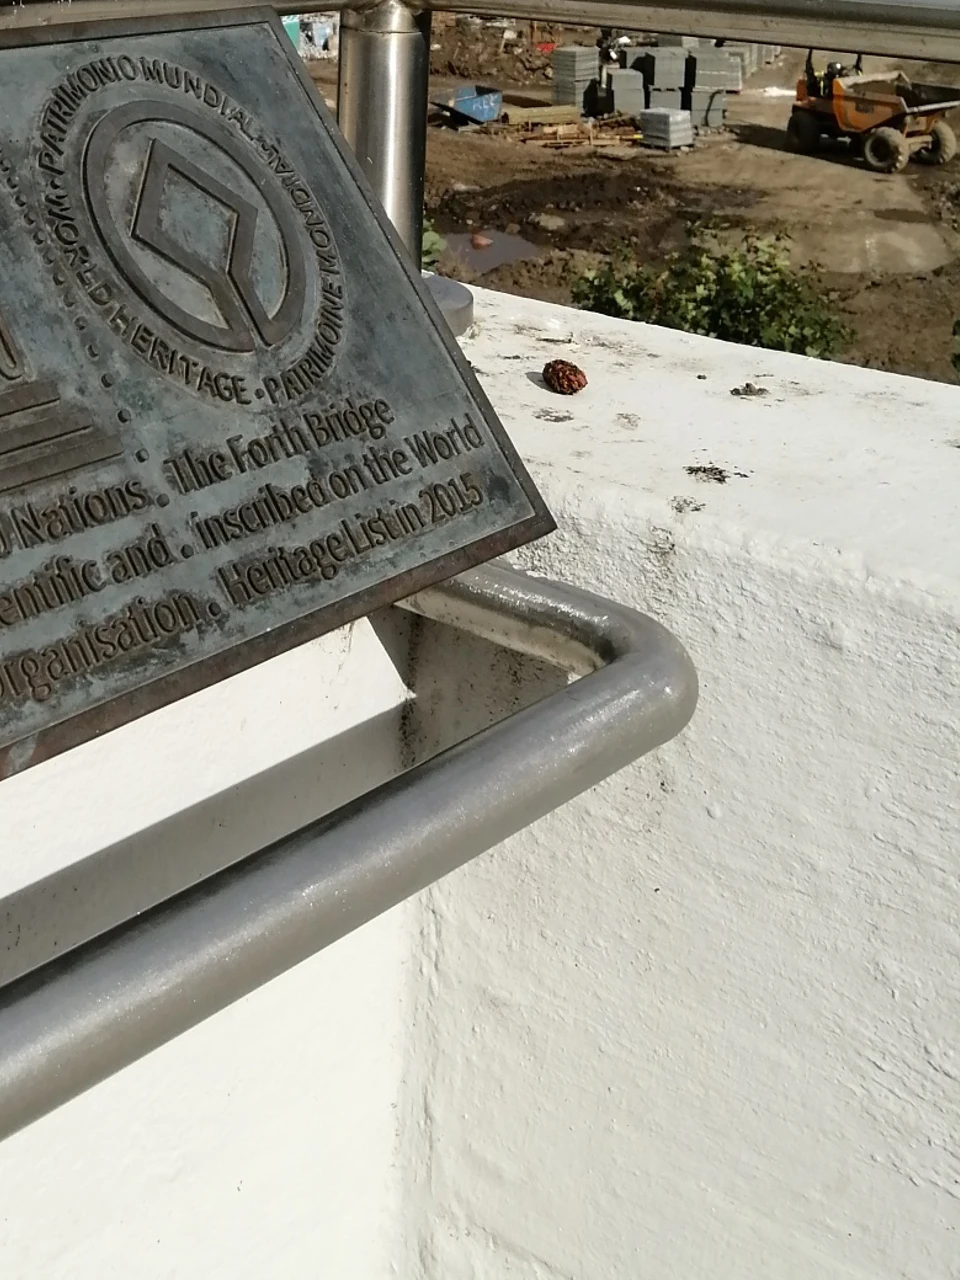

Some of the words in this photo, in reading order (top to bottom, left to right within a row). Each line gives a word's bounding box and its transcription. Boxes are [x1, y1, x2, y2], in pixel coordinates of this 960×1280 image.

[38, 54, 138, 176] PATRIMONIO
[139, 56, 257, 142] MUNDIAL
[265, 143, 340, 276] MONDIAL
[44, 194, 114, 306] WORLD
[109, 304, 253, 405] HERITAGE
[262, 277, 344, 405] PATRIMOINE
[165, 450, 231, 495] The
[227, 417, 311, 473] Forth
[307, 394, 395, 447] Bridge
[190, 473, 327, 550] inscribed
[327, 463, 365, 497] on
[363, 443, 413, 487] the
[405, 412, 485, 465] World
[10, 480, 149, 550] Nations
[105, 522, 176, 584] and
[218, 534, 347, 604] Heritage
[343, 514, 393, 555] List
[389, 500, 426, 539] in
[419, 473, 484, 523] 2015
